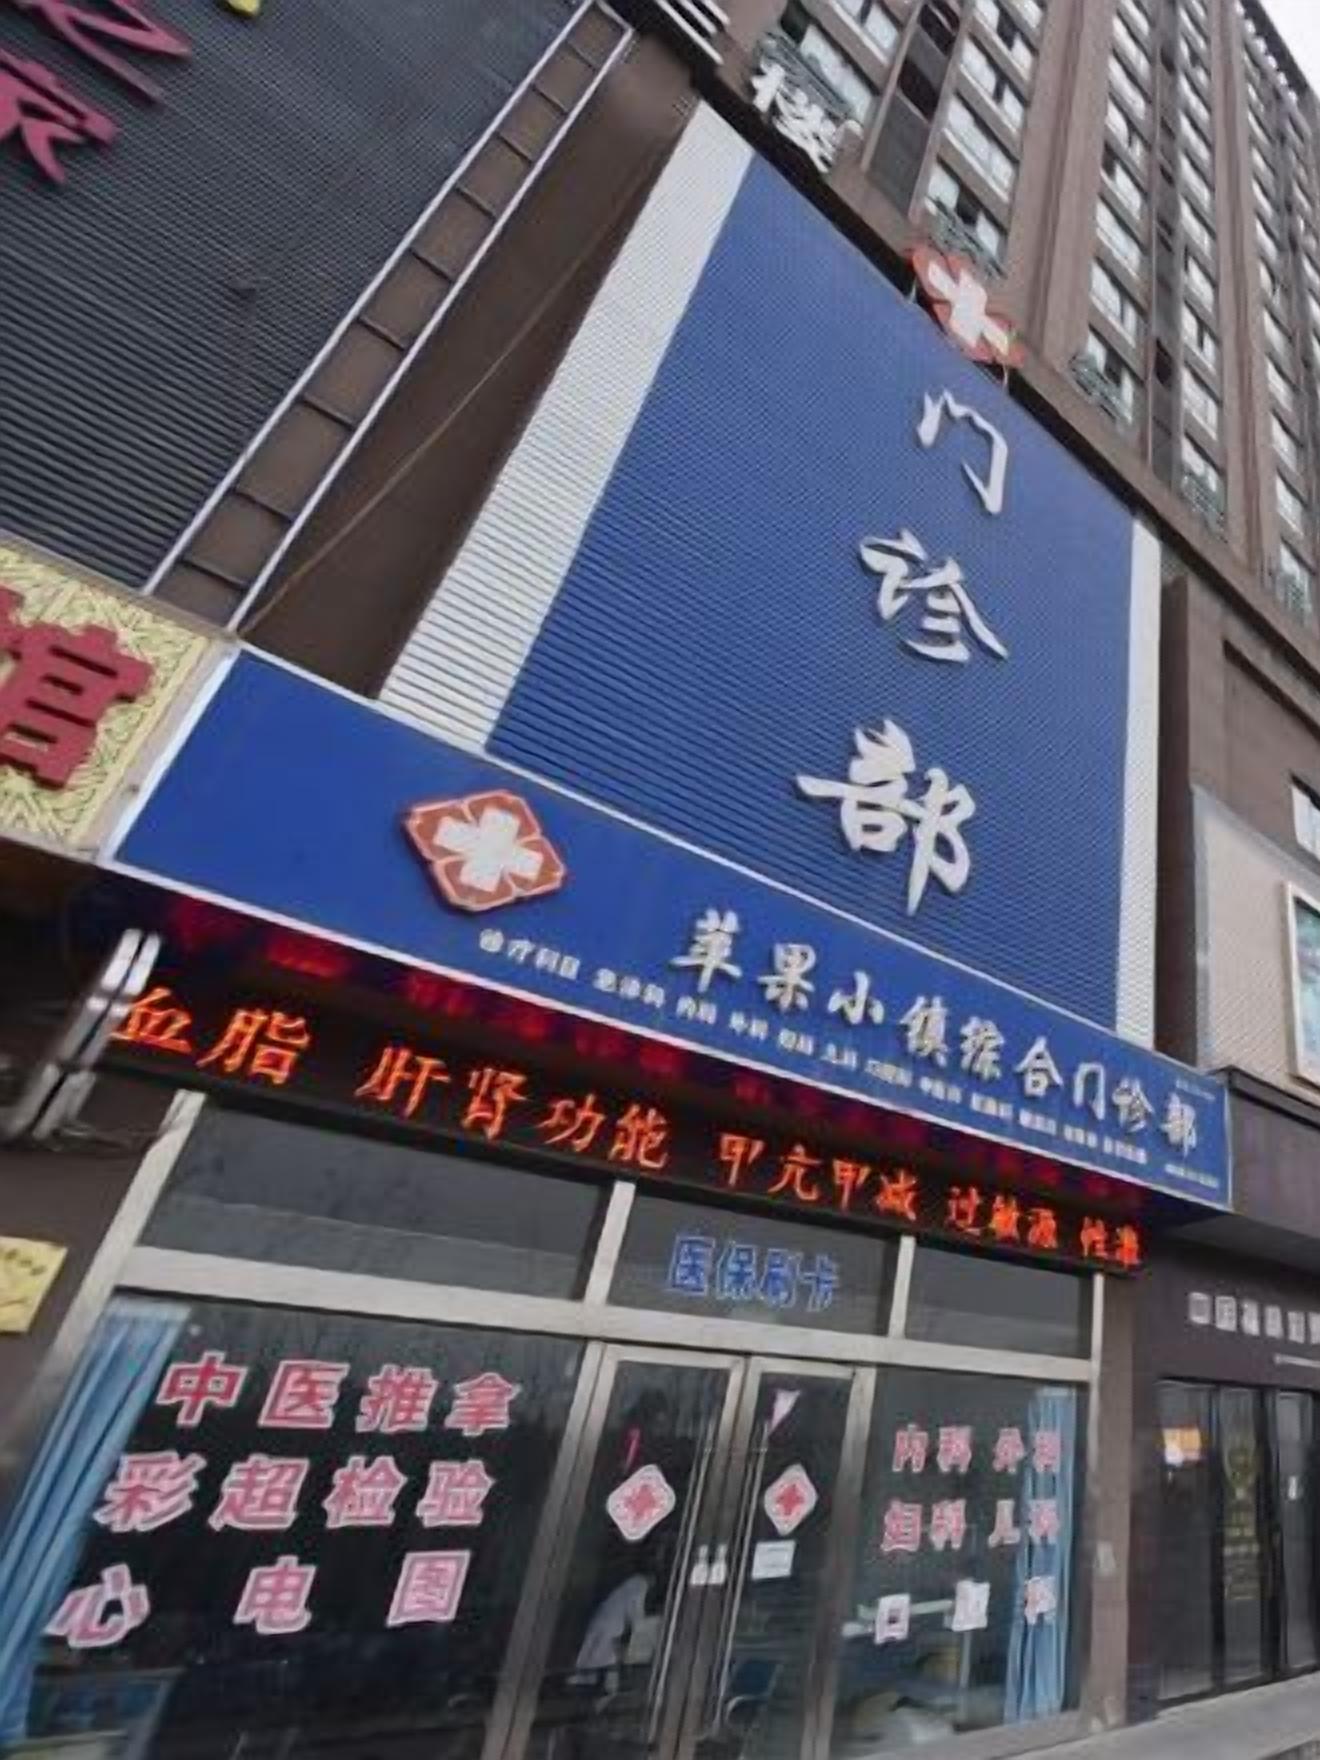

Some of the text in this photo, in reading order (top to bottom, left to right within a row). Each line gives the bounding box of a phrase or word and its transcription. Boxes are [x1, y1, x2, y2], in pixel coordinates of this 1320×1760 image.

[797, 389, 1009, 917] 门诊部
[108, 985, 312, 1087] 血脂
[354, 1045, 671, 1171] 肝肾功能
[717, 1131, 918, 1222] 甲亢甲减
[667, 1233, 841, 1314] 医保刷卡
[156, 1350, 522, 1436] 中医推拿
[93, 1450, 497, 1533] 彩超检验
[44, 1548, 472, 1650] 心电图
